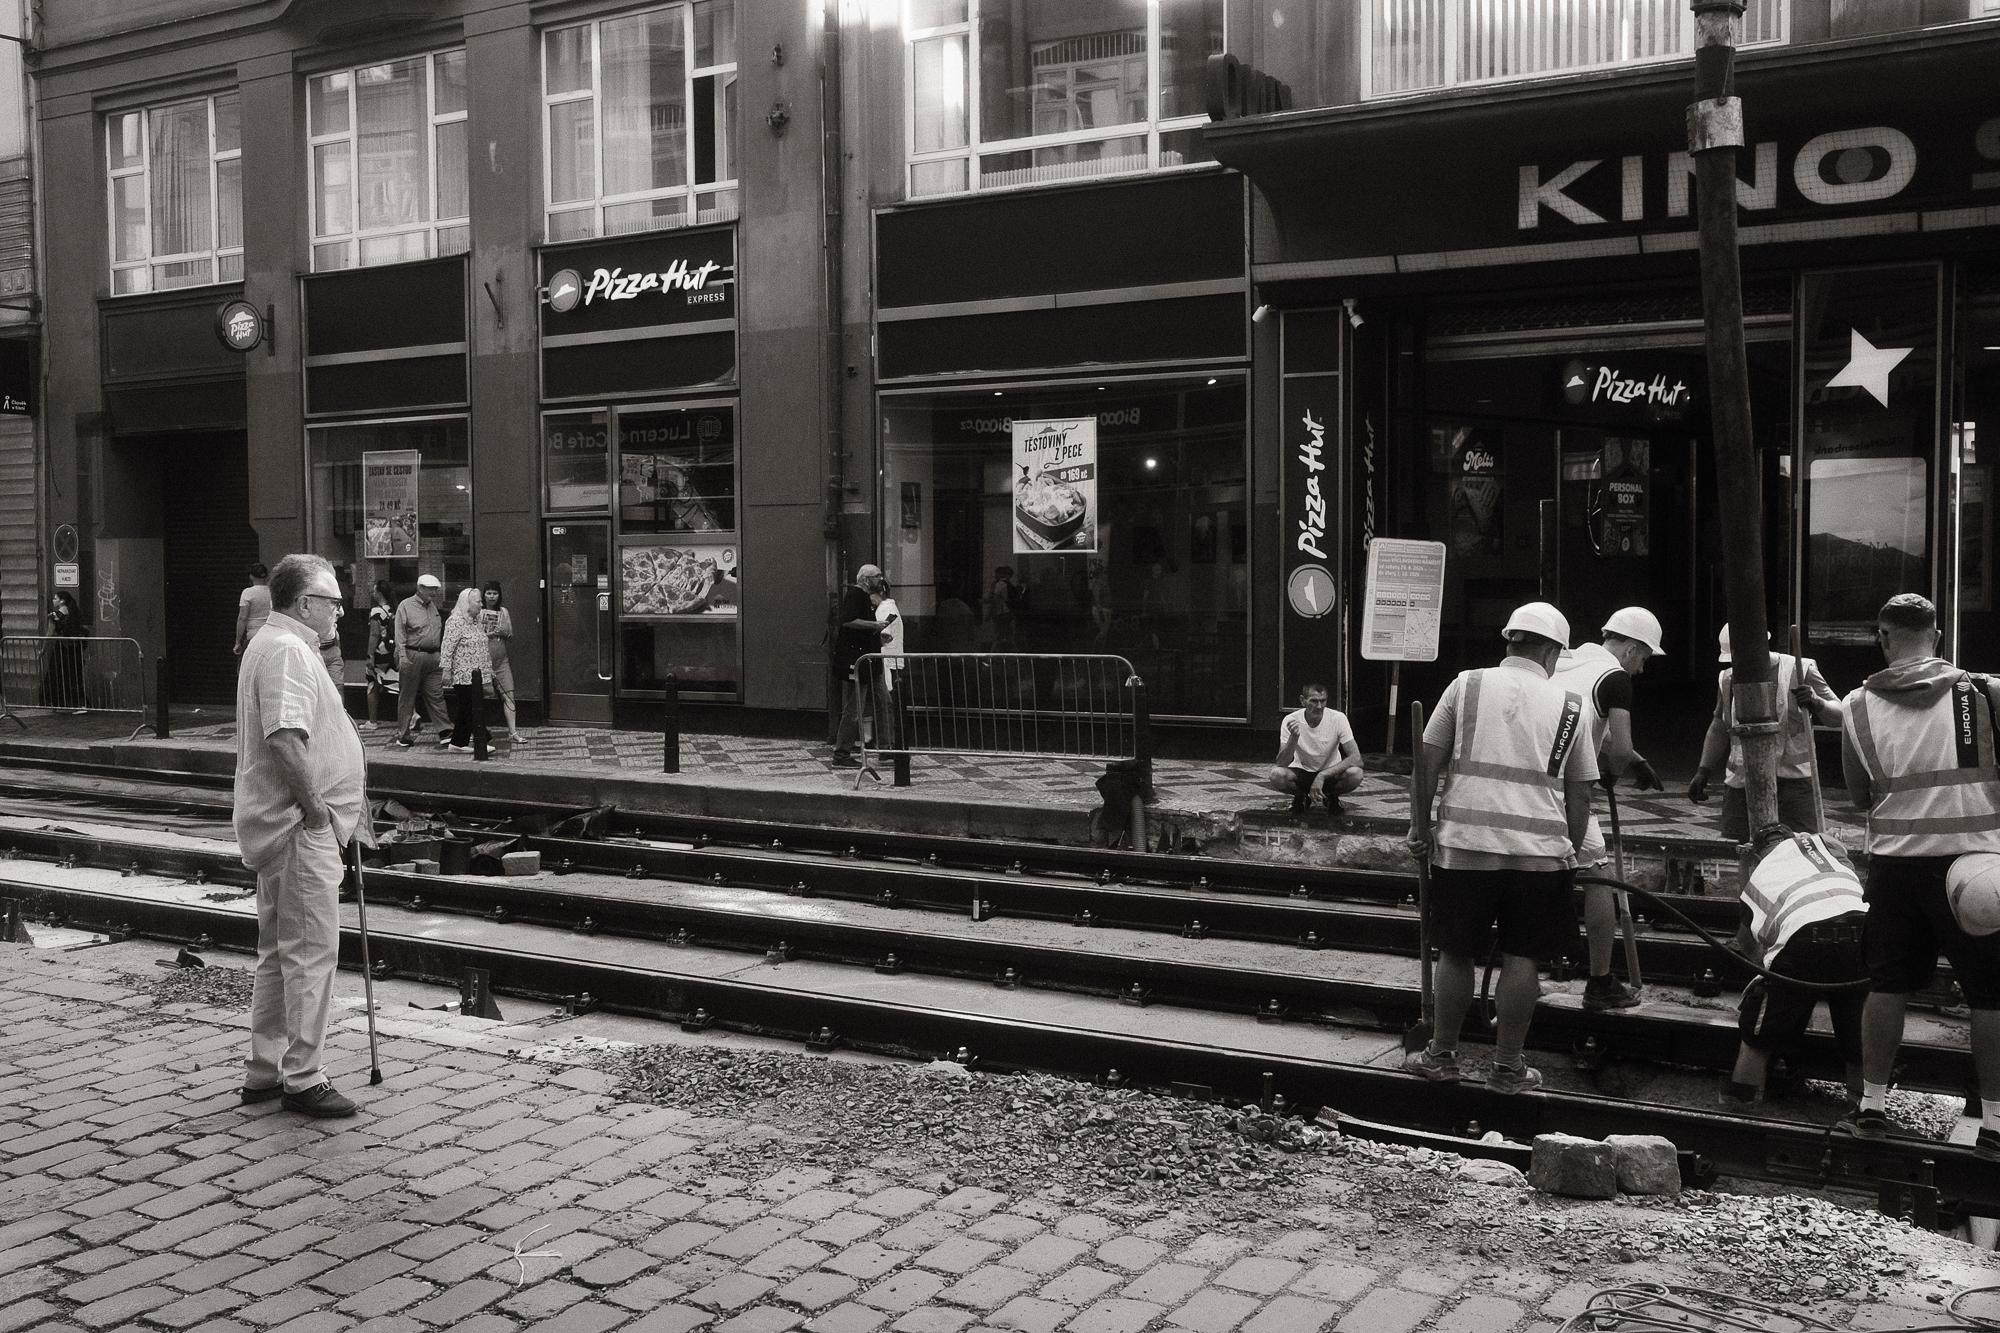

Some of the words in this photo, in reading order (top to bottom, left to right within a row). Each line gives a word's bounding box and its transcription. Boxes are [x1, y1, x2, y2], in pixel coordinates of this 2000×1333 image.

[1517, 126, 1917, 230] KINO
[586, 267, 659, 306] Pizza
[659, 259, 721, 294] Hut
[687, 291, 725, 304] EXPRESS
[230, 321, 255, 337] Pizza
[235, 328, 253, 341] Hut
[1592, 366, 1646, 403] Pizza
[1648, 373, 1687, 406] Hut
[1024, 432, 1067, 453] TĚSTOVINY
[1298, 408, 1326, 473] Hut
[1054, 447, 1060, 461] Z
[1062, 443, 1083, 460] PECE
[1463, 450, 1494, 471] Melts
[1067, 467, 1080, 481] 169
[1609, 482, 1644, 493] PERSONAL
[1617, 493, 1635, 504] BOX
[1297, 475, 1328, 559] Pizza
[1960, 694, 1972, 745] EUROVIA
[1554, 714, 1575, 760] EUROVIA
